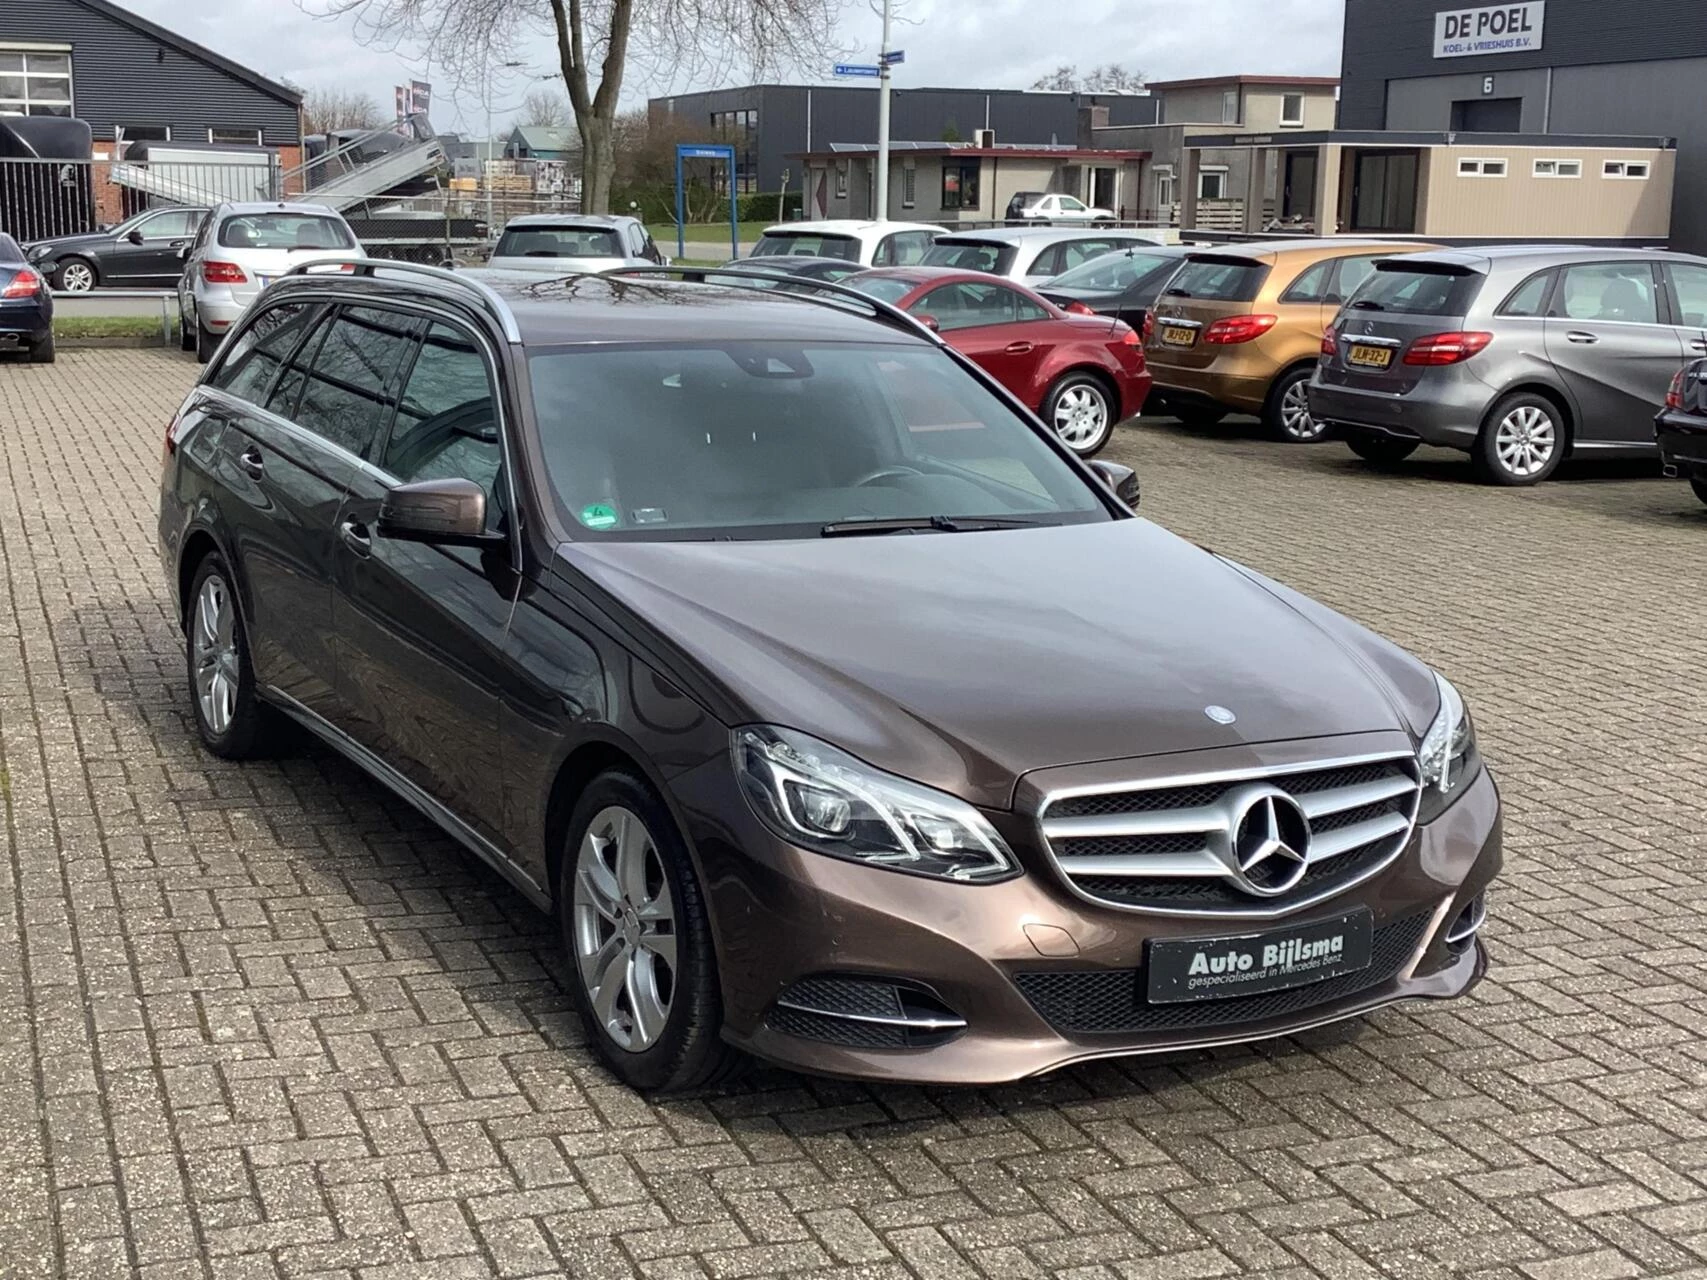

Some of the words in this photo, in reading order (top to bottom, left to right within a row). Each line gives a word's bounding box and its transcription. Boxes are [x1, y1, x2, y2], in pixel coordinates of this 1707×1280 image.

[1444, 14, 1472, 39] DE
[1477, 7, 1532, 36] POEL
[1467, 42, 1473, 51] &
[1474, 38, 1514, 51] VRIESHUIS
[1515, 37, 1532, 48] B.V.
[1483, 77, 1493, 93] 6
[1188, 951, 1254, 975] Auto
[1262, 935, 1344, 968] Bijlsma
[1188, 968, 1267, 990] gespecialiseerd
[1269, 966, 1278, 977] in
[1279, 958, 1321, 976] Mercedes
[1322, 953, 1344, 966] Benz
